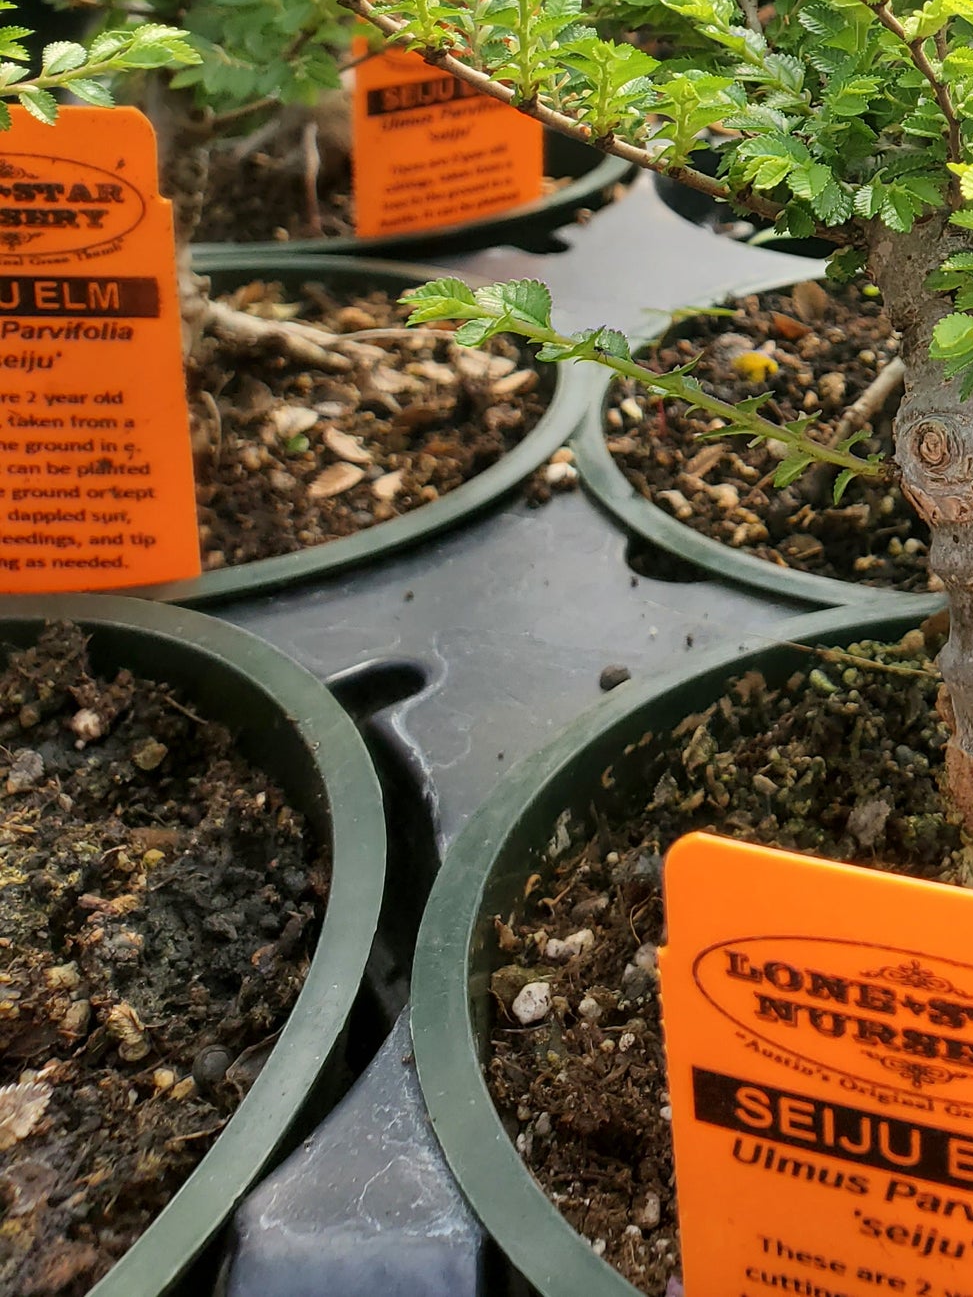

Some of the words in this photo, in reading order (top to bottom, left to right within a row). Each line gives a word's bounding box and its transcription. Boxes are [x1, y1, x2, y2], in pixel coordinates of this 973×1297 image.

[12, 183, 124, 203] STAR
[0, 208, 109, 228] SERY
[34, 281, 120, 310] ELM
[2, 320, 134, 341] Parvifolia
[0, 351, 62, 373] eiju'
[0, 392, 20, 403] re
[26, 390, 36, 403] 2
[44, 392, 88, 406] year
[93, 390, 123, 404] old
[8, 414, 64, 428] taken
[70, 415, 117, 429] from
[124, 418, 135, 429] a
[25, 439, 94, 454] ground
[101, 439, 117, 452] in
[7, 463, 41, 475] can
[46, 461, 71, 475] be
[77, 460, 150, 478] planted
[12, 486, 80, 501] ground
[86, 488, 104, 499] or
[111, 486, 155, 502] kept
[8, 508, 86, 524] dappled
[0, 532, 82, 548] eedings,
[89, 533, 123, 546] and
[130, 532, 156, 549] tip
[25, 557, 46, 569] as
[51, 555, 129, 570] needed.
[724, 949, 896, 1016] LONE
[839, 1075, 935, 1113] Original
[735, 1086, 921, 1167] SEIJU
[732, 1136, 869, 1196] Ulmus
[757, 1234, 846, 1277] These
[857, 1266, 906, 1293] are
[916, 1277, 932, 1297] 2
